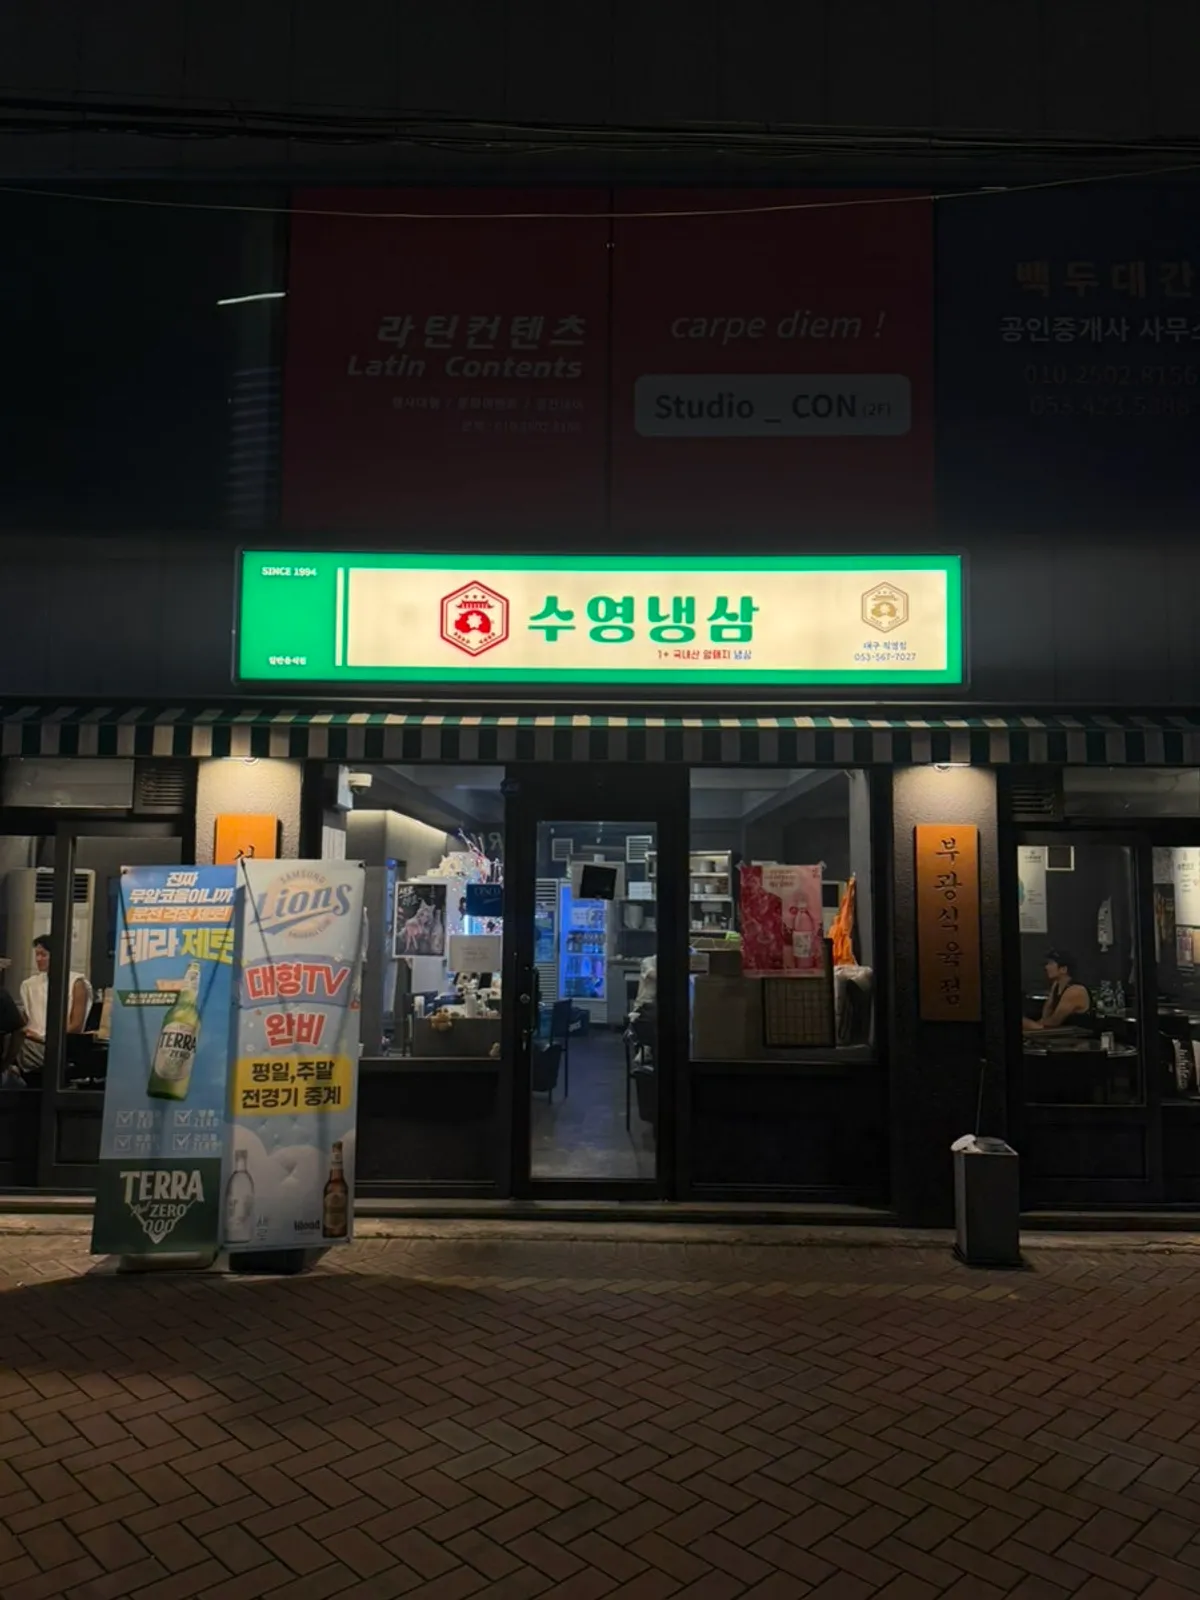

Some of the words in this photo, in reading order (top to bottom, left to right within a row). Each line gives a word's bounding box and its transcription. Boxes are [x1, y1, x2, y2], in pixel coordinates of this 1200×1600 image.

[1015, 260, 1196, 299] 백두대간
[377, 314, 587, 350] 라틴컨텐츠
[669, 314, 768, 346] carpe
[776, 309, 863, 339] diem
[998, 316, 1131, 343] 공인중개사
[347, 354, 427, 378] Latin
[444, 355, 583, 379] Contents
[654, 391, 756, 420] Studio
[791, 393, 858, 419] CON
[261, 566, 292, 576] SINCE
[293, 566, 318, 577] 1994
[527, 595, 760, 644] 수영냉삼
[673, 649, 701, 660] 국내산
[166, 871, 199, 887] 진짜
[248, 883, 353, 926] Lions
[119, 928, 180, 966] 테라
[180, 927, 235, 966] 제로
[245, 961, 351, 1000] 대형TV
[264, 1011, 328, 1049] 완비
[252, 1060, 335, 1084] 평일,주말
[242, 1087, 298, 1109] 전경기
[304, 1085, 342, 1107] 중계
[120, 1169, 205, 1204] TERRA
[149, 1203, 188, 1218] ZERO
